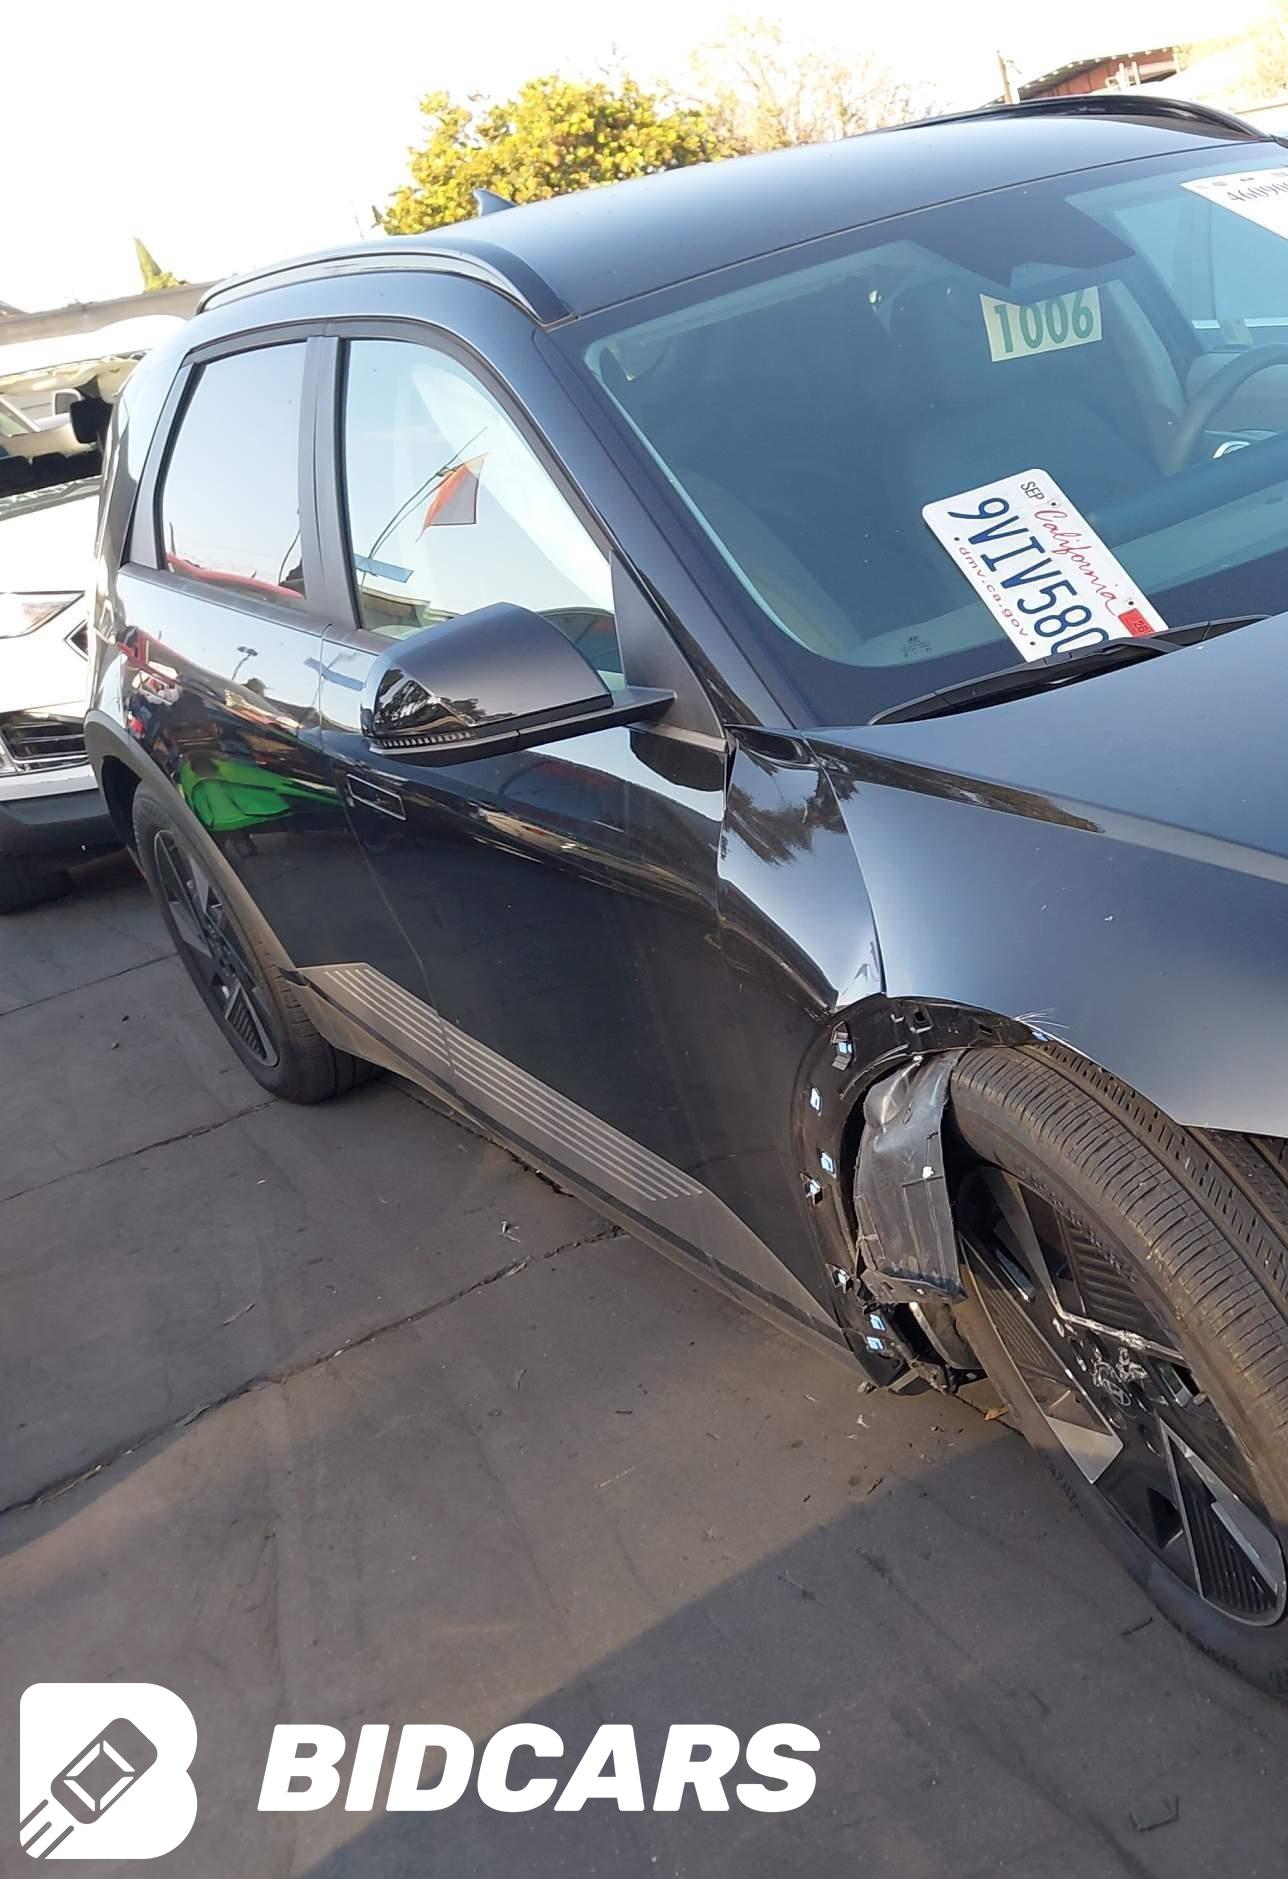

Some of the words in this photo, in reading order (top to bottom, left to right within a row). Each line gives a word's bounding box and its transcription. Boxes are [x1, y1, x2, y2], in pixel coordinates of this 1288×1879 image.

[993, 289, 1094, 353] 1006
[1020, 480, 1045, 501] SEP
[958, 546, 1028, 638] dmv.ca.gov
[1033, 509, 1118, 617] California
